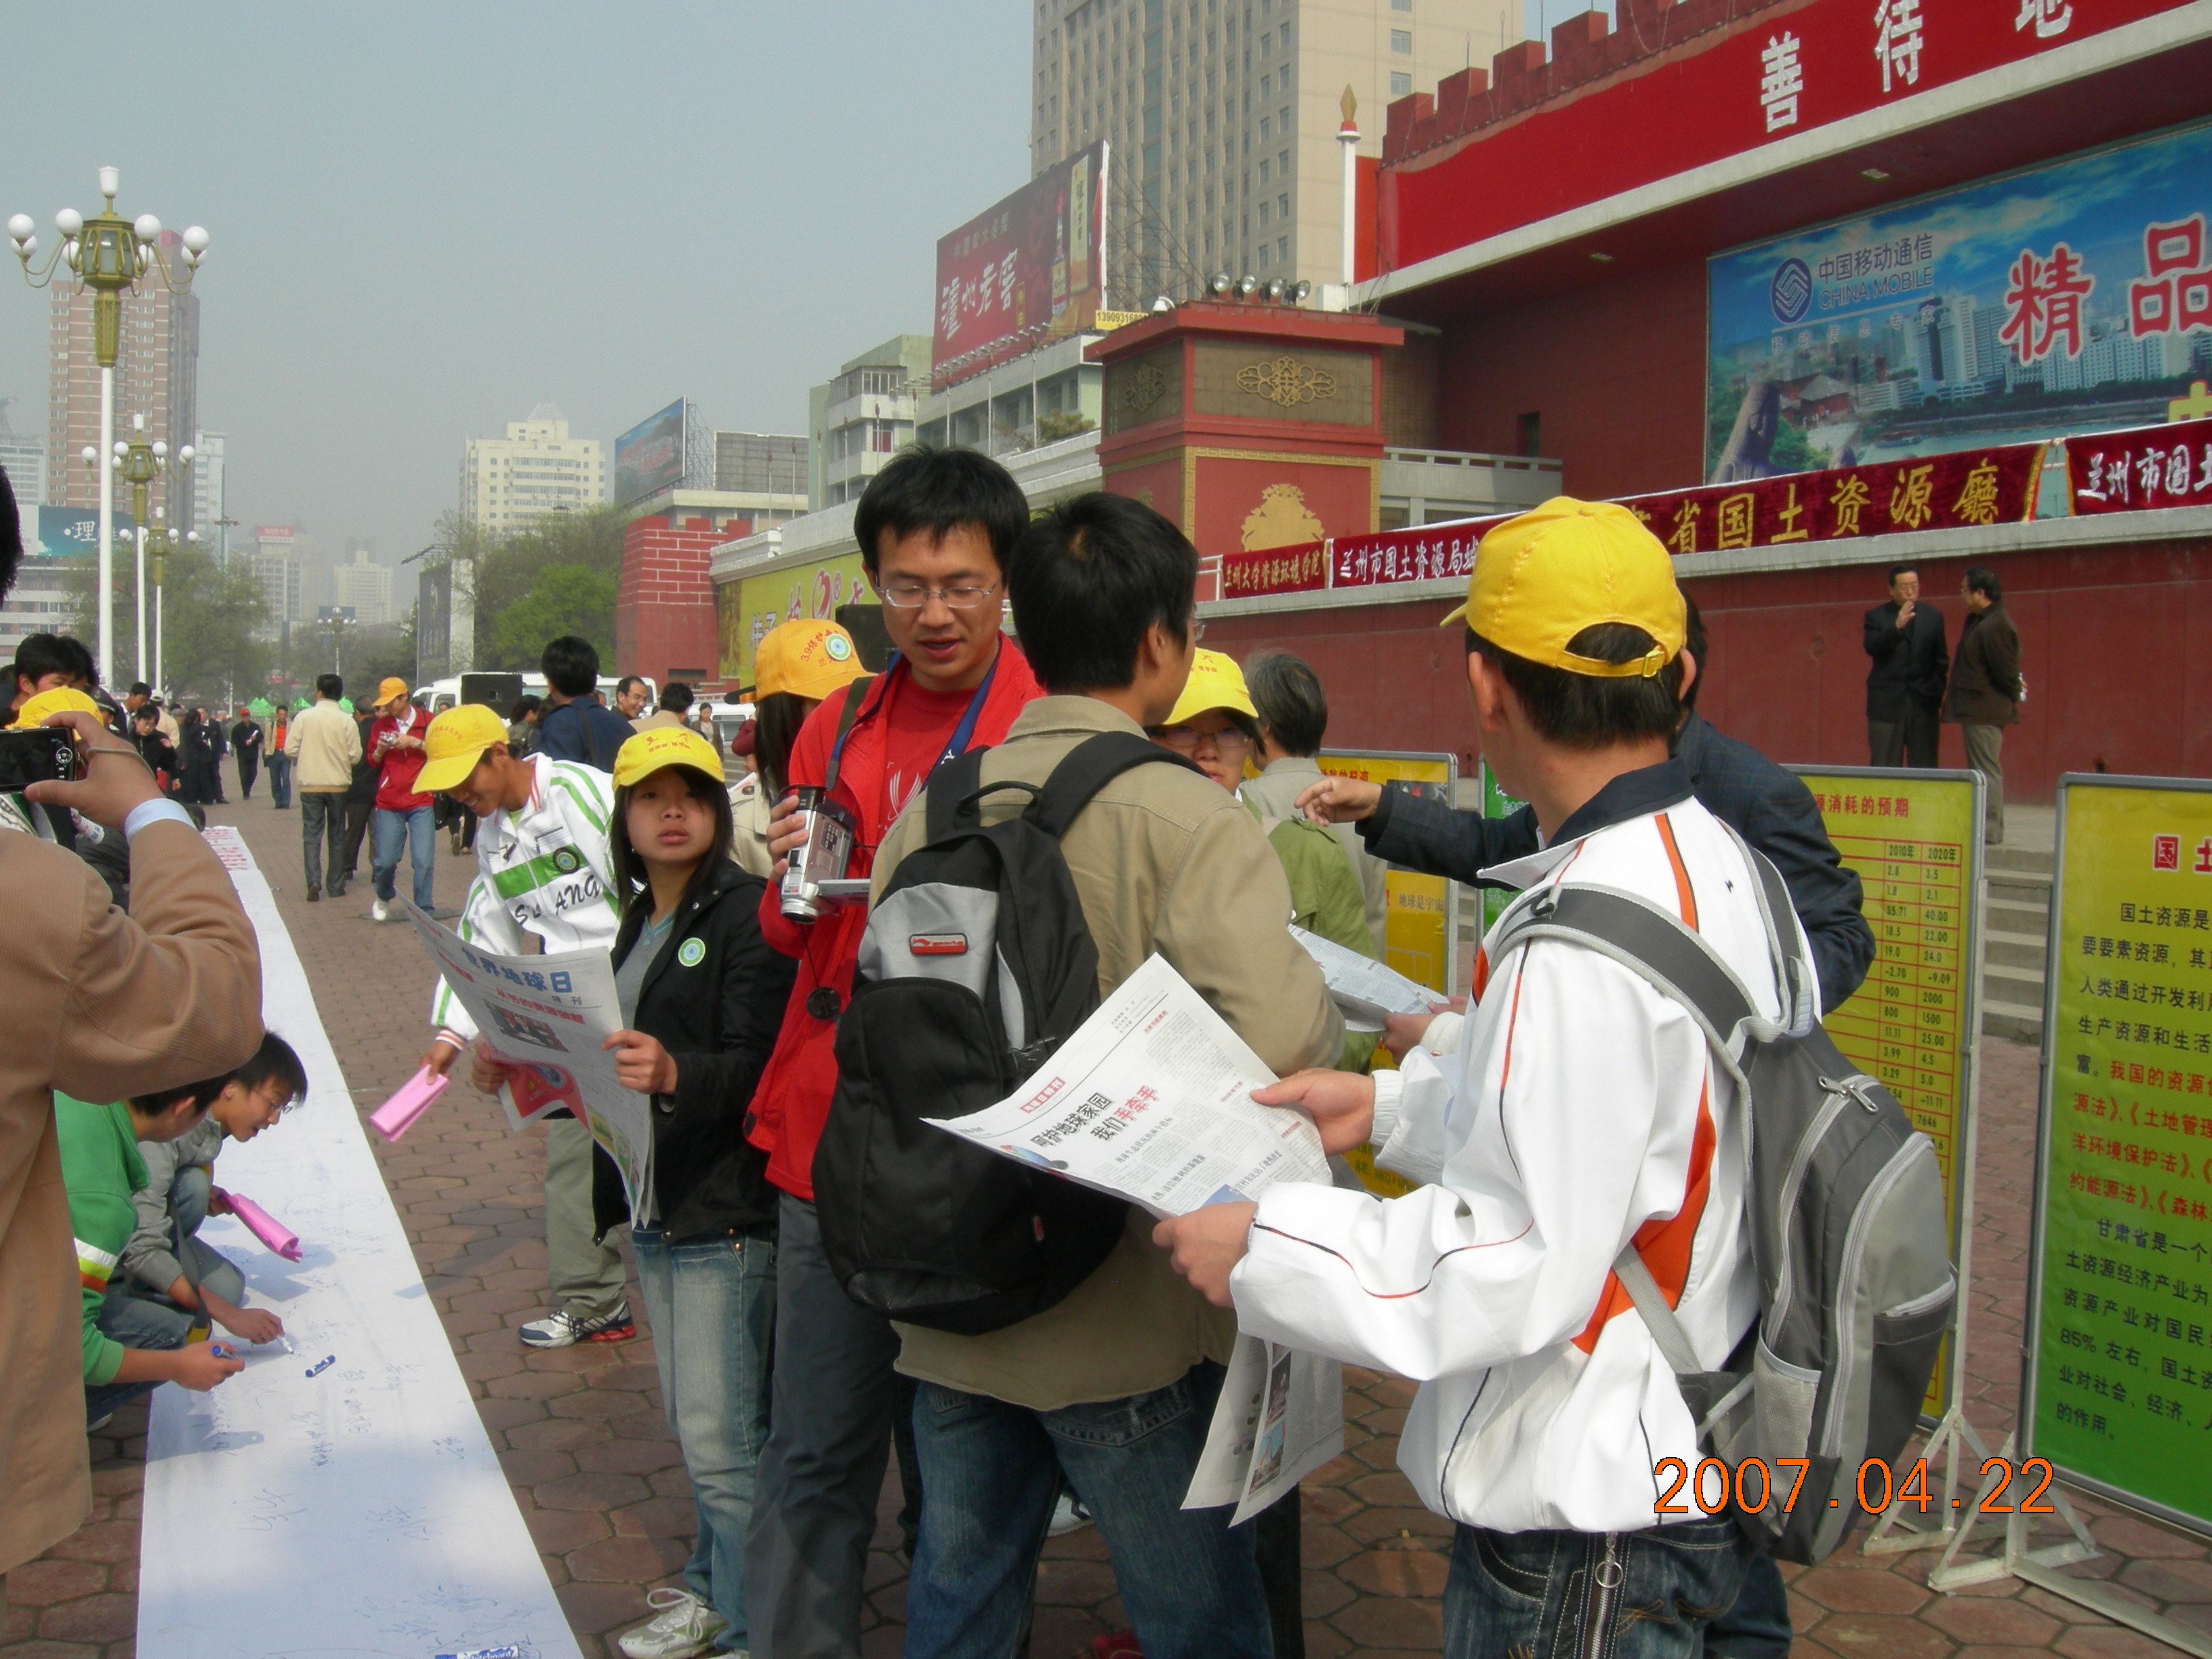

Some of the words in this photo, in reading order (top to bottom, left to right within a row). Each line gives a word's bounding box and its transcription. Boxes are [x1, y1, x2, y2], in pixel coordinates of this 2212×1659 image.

[1818, 233, 1933, 284] 中国移动通信
[1818, 283, 1869, 310] CHINA
[1873, 265, 1933, 298] MOBILE
[2000, 212, 2212, 368] 精品
[1628, 458, 1999, 553] 省国土资源廳
[1889, 844, 1914, 859] 2010年
[1927, 848, 1957, 862] 2020年
[2152, 834, 2212, 874] 国土
[1926, 869, 1939, 880] 3.5
[1927, 889, 1938, 901] 2.1
[1925, 909, 1948, 922] 40.00
[1885, 925, 1901, 937] 18.5
[1925, 930, 1948, 943] 22.00
[1924, 951, 1942, 963] 24.0
[2082, 935, 2212, 970] 要要素资源，其
[1885, 968, 1906, 979] -2.70
[1927, 973, 1950, 985] -9.09
[1885, 986, 1900, 997] 900
[1923, 991, 1943, 1004] 2000
[1923, 1012, 1940, 1025] 1500
[1922, 1033, 1945, 1046] 25.00
[2078, 1015, 2211, 1054] 生产资源和生活
[1921, 1054, 1934, 1065] 4.5
[1921, 1074, 1933, 1086] 5.0
[1030, 1092, 1113, 1147] 呵护地球家园
[1090, 1084, 1160, 1141] 我们手牵手
[2069, 1171, 2212, 1221] 约能源法》、《森林
[2097, 1217, 2212, 1263] 甘肃省是一个
[2063, 1287, 2212, 1349] 资源产业对国民
[2059, 1365, 2212, 1430] 业对社会、经济、
